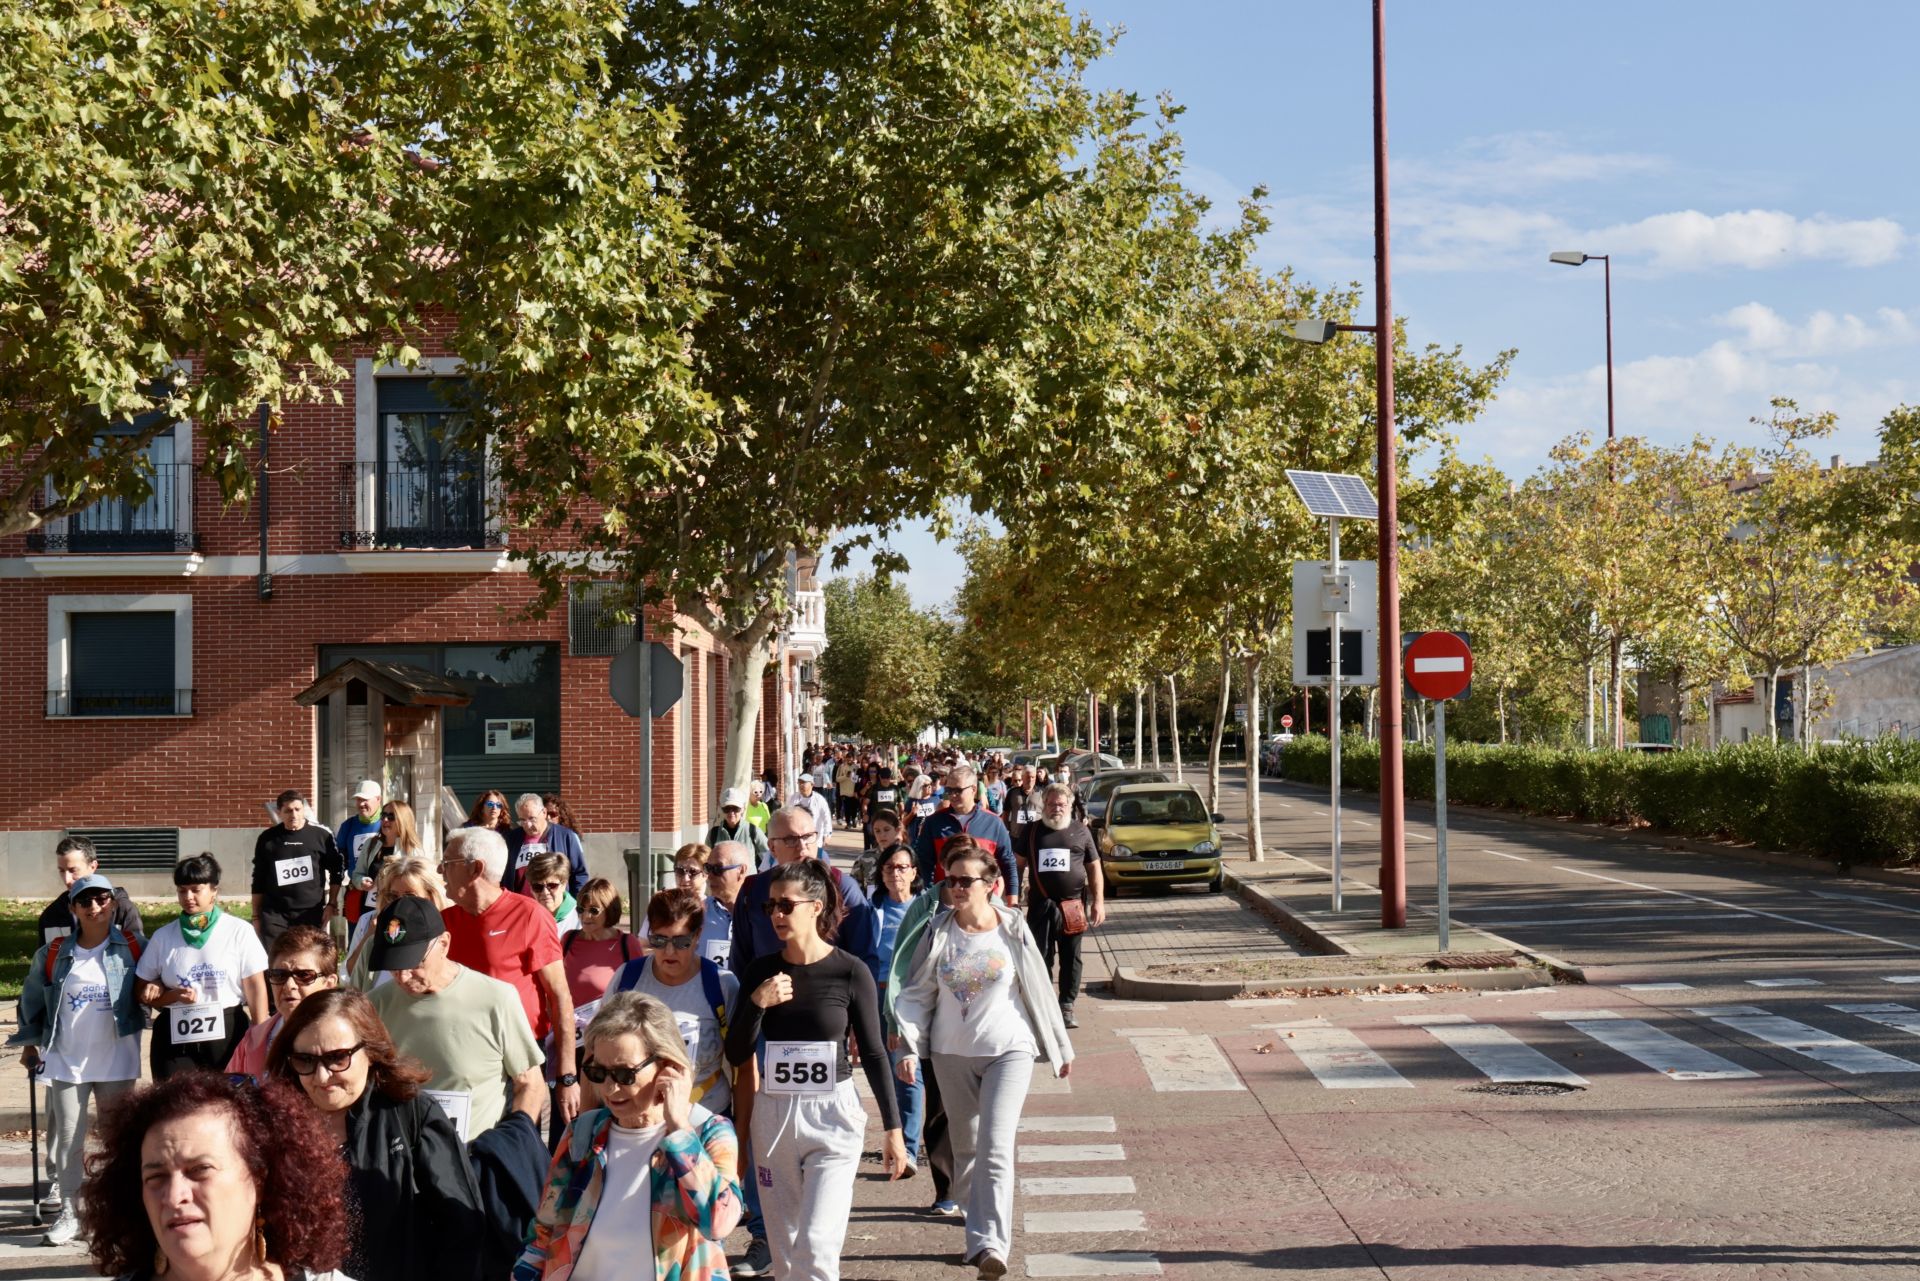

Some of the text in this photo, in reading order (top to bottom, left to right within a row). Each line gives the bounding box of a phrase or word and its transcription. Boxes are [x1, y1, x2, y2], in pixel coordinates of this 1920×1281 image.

[1042, 858, 1066, 868] 424
[282, 866, 309, 880] 309
[190, 962, 213, 972] daño
[177, 1016, 217, 1036] 027
[774, 1062, 828, 1084] 558
